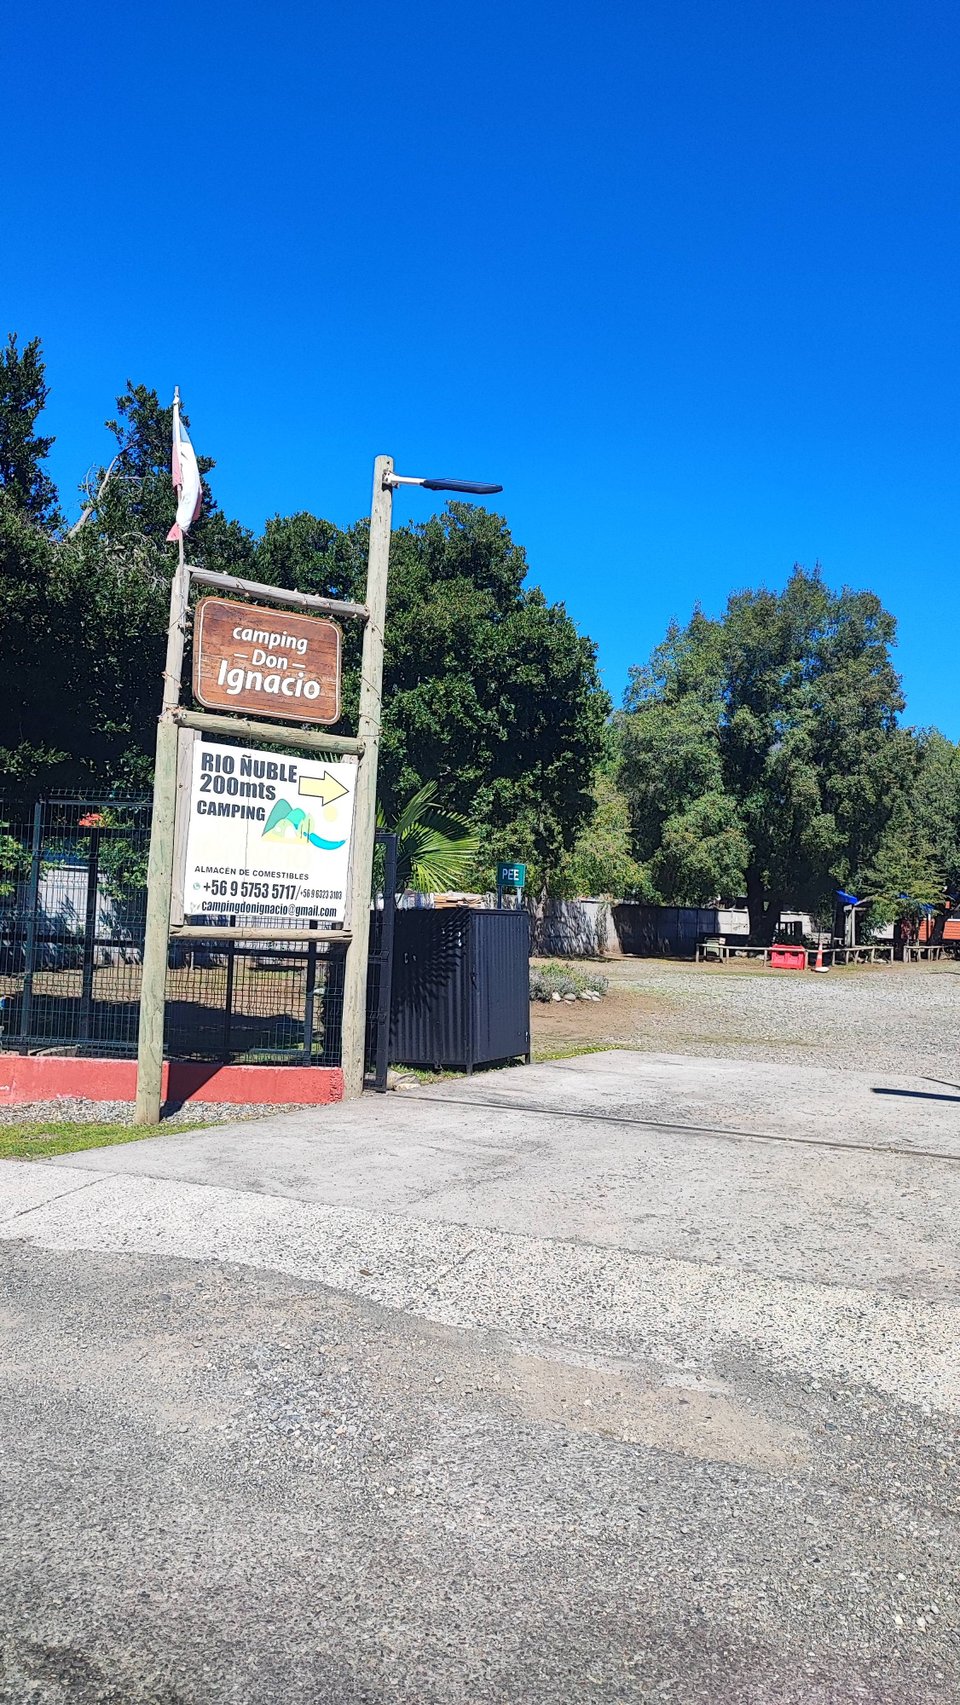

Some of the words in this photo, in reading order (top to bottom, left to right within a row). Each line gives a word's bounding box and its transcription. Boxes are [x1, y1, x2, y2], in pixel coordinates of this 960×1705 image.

[232, 626, 308, 655] camping
[251, 649, 288, 670] Don
[217, 659, 321, 700] Ignacio
[201, 752, 235, 775] RIO
[240, 754, 298, 783] ÑUBLE
[199, 773, 276, 801] 200mts
[196, 800, 266, 821] CAMPING
[239, 868, 250, 877] DE
[252, 870, 309, 880] COMESTIBLES
[502, 868, 521, 881] PEE
[203, 880, 227, 896] +56
[230, 880, 238, 897] 9
[240, 882, 269, 899] 5753
[201, 900, 337, 918] campingdonignacio@gmail.com
